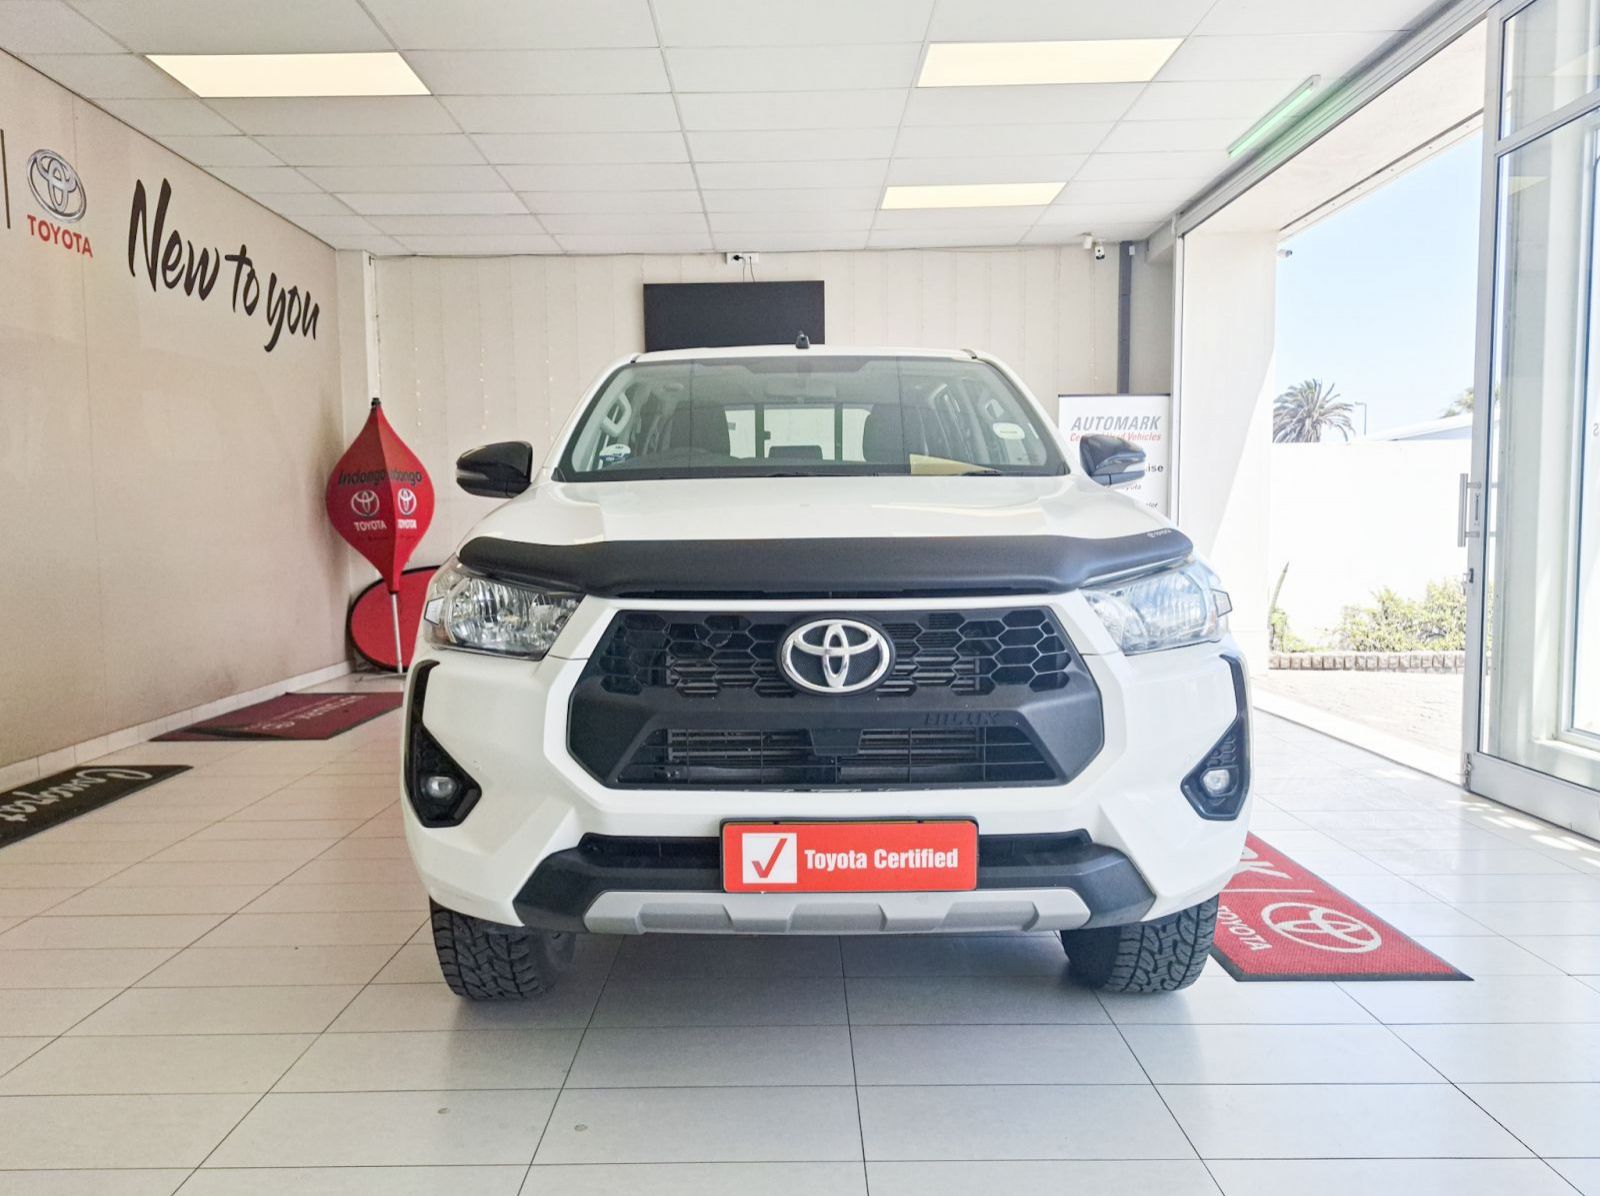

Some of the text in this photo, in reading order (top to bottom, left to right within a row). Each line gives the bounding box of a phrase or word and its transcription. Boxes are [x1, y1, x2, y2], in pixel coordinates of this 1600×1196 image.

[27, 214, 93, 257] TOYOTA
[128, 178, 320, 352] New to you
[1071, 416, 1161, 431] AUTOMARK
[1127, 432, 1162, 442] Vehicles
[354, 520, 387, 531] TOYOTA
[804, 848, 959, 871] Toyota Certified
[1217, 904, 1273, 951] TOYOTA
